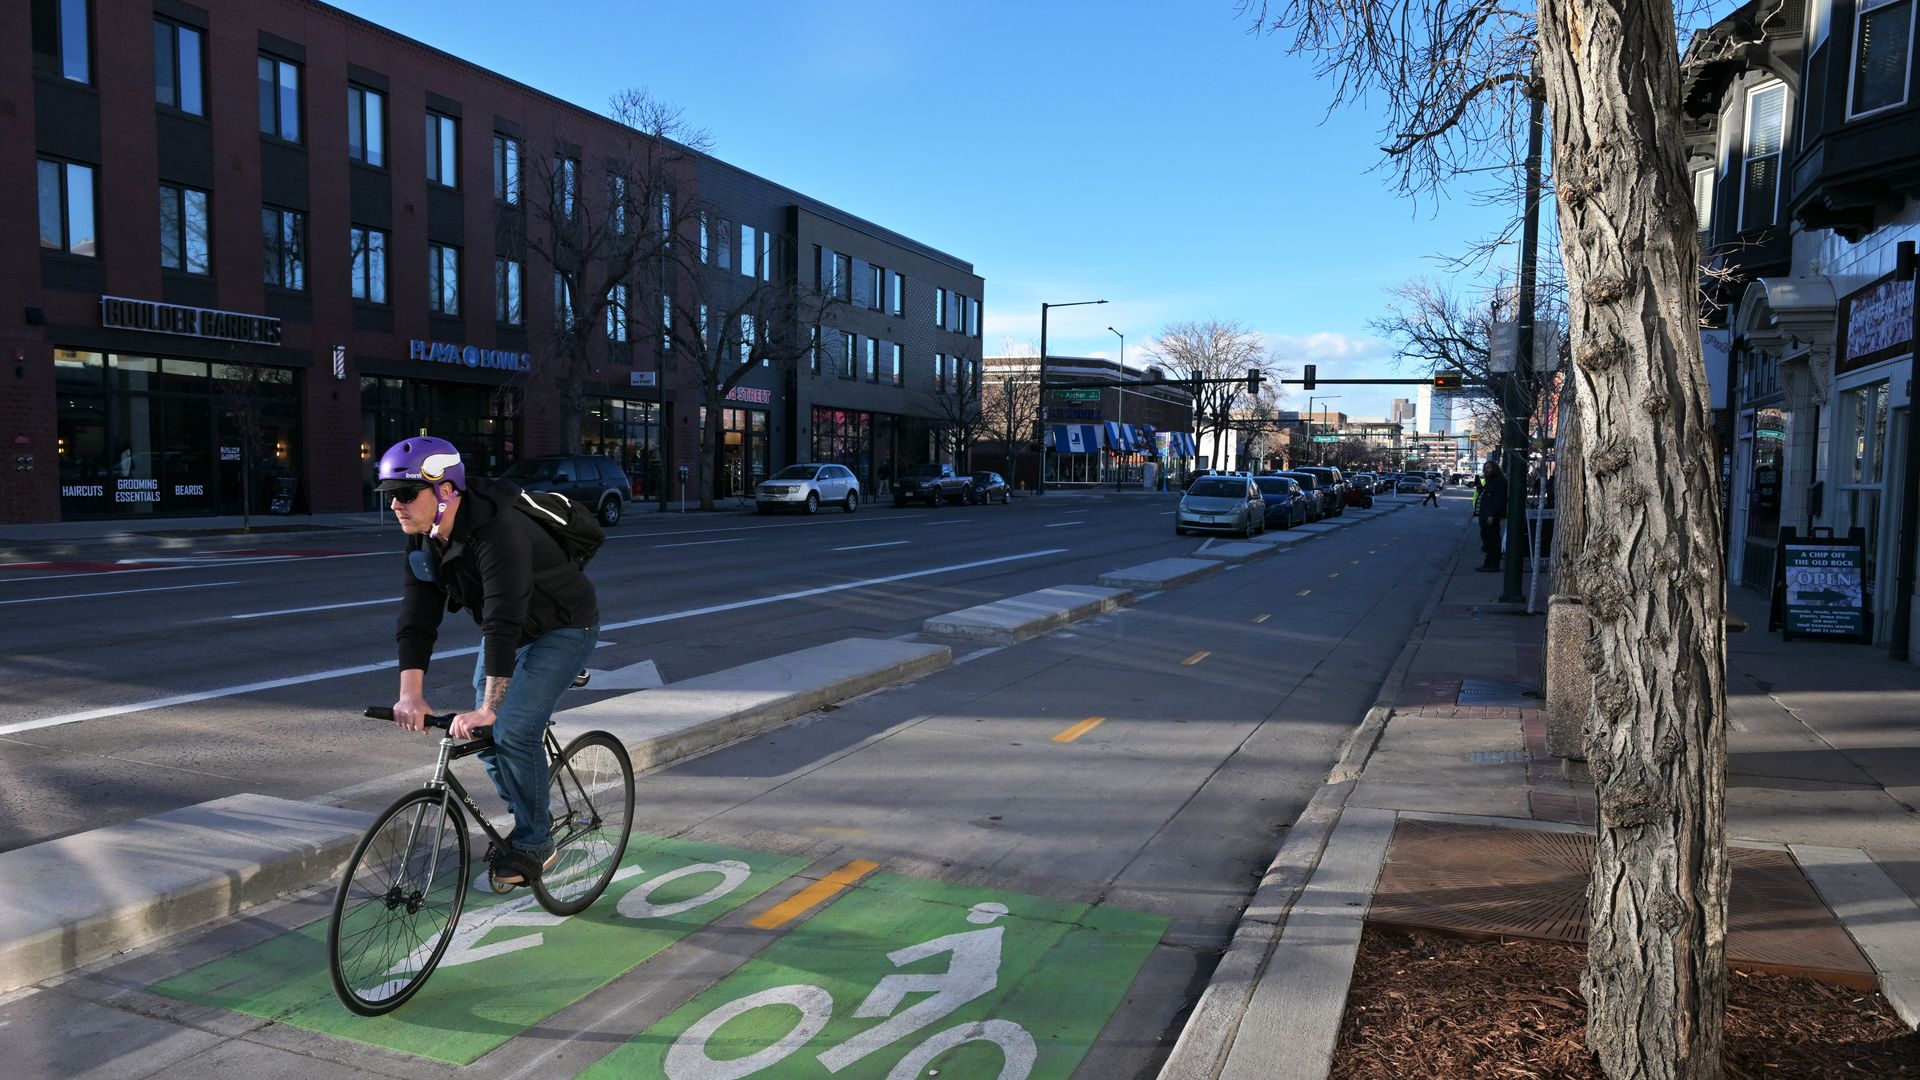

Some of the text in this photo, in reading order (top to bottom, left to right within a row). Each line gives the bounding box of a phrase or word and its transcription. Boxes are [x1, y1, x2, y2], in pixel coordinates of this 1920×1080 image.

[107, 299, 281, 342] BOULDER BARBERS
[1704, 334, 1730, 353] Pub
[410, 339, 531, 372] PLAYA BOWLS
[738, 387, 772, 404] STREET
[62, 485, 104, 497] HAIRCUTS
[117, 479, 158, 490] GROOMING
[175, 484, 204, 496] BEARDS
[115, 491, 161, 502] ESSENTIALS
[1797, 572, 1851, 586] OPEN
